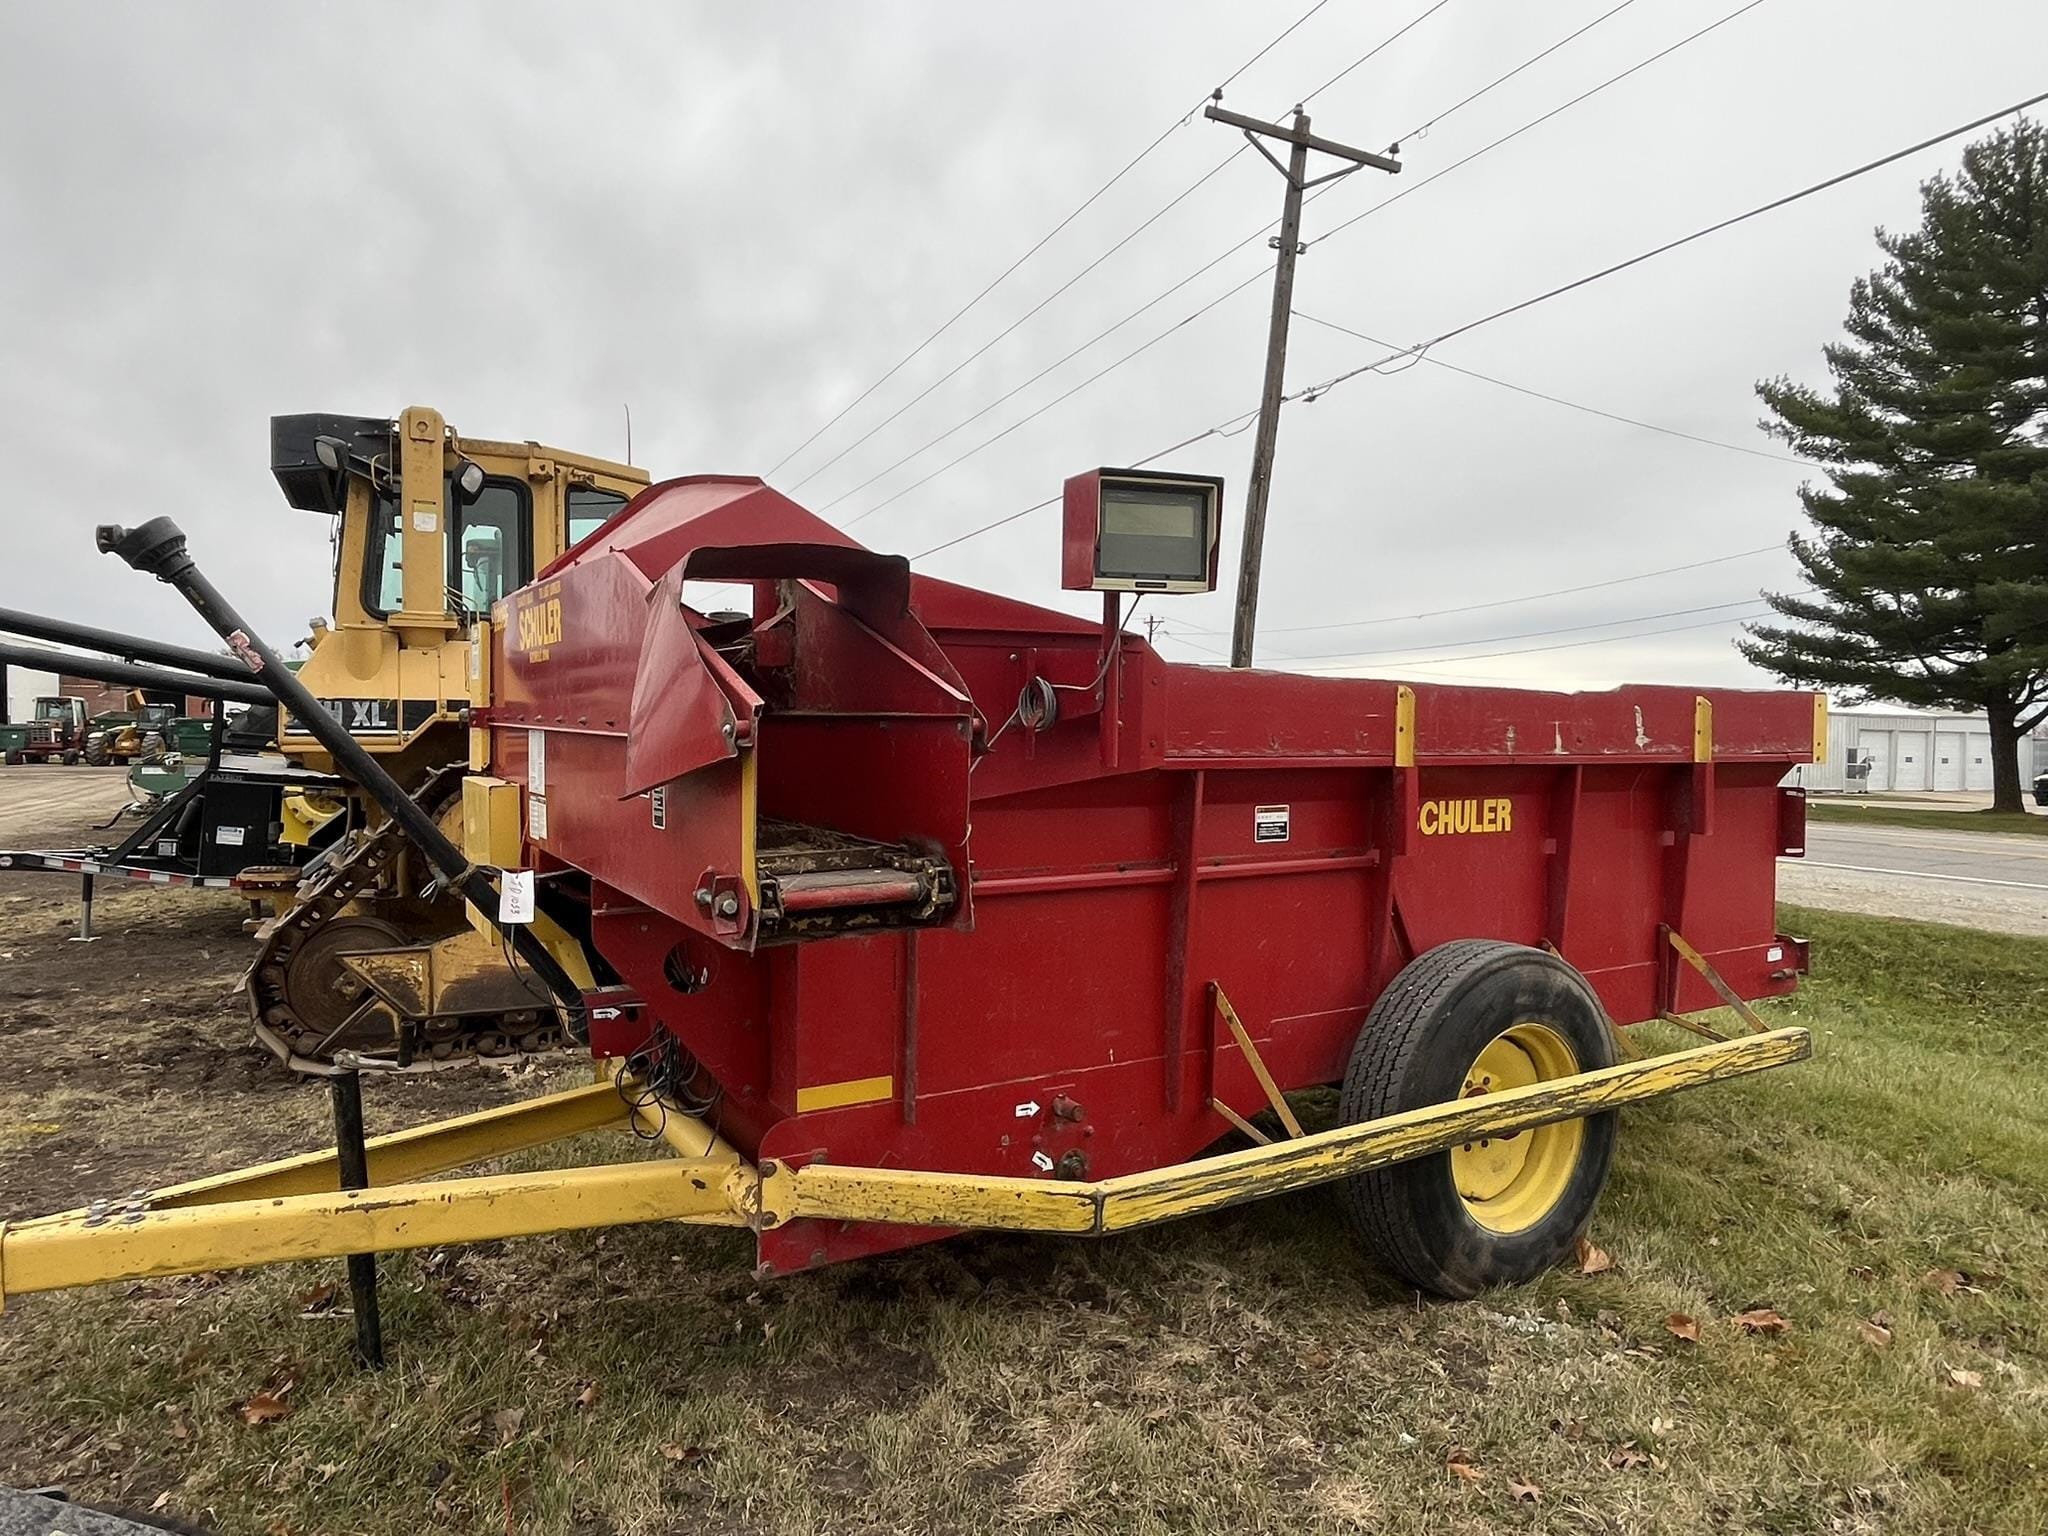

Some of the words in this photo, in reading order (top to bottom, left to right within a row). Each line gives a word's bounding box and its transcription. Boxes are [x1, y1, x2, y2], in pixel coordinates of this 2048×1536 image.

[519, 598, 562, 651] SCHULER
[351, 700, 387, 727] XL
[1417, 798, 1512, 836] CHULER
